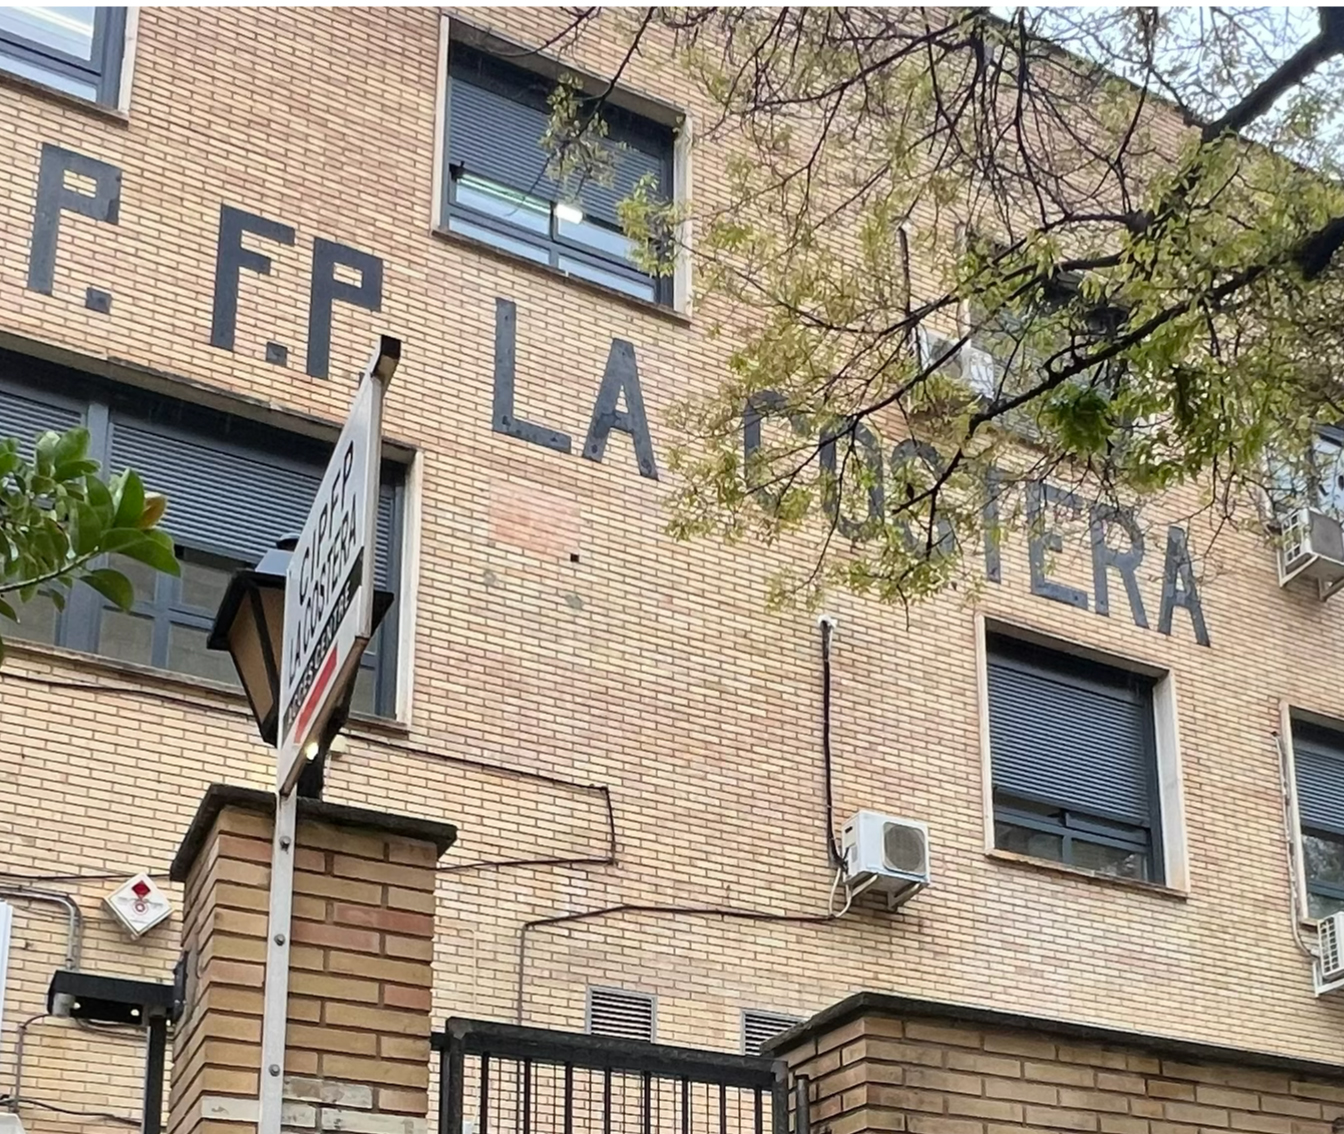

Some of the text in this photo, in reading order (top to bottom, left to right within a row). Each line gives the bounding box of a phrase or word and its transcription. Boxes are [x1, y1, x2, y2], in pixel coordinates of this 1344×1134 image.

[210, 203, 385, 379] F.P
[491, 297, 658, 480] LA
[289, 494, 356, 690] LA COSTERA
[315, 580, 350, 670] CENTRE
